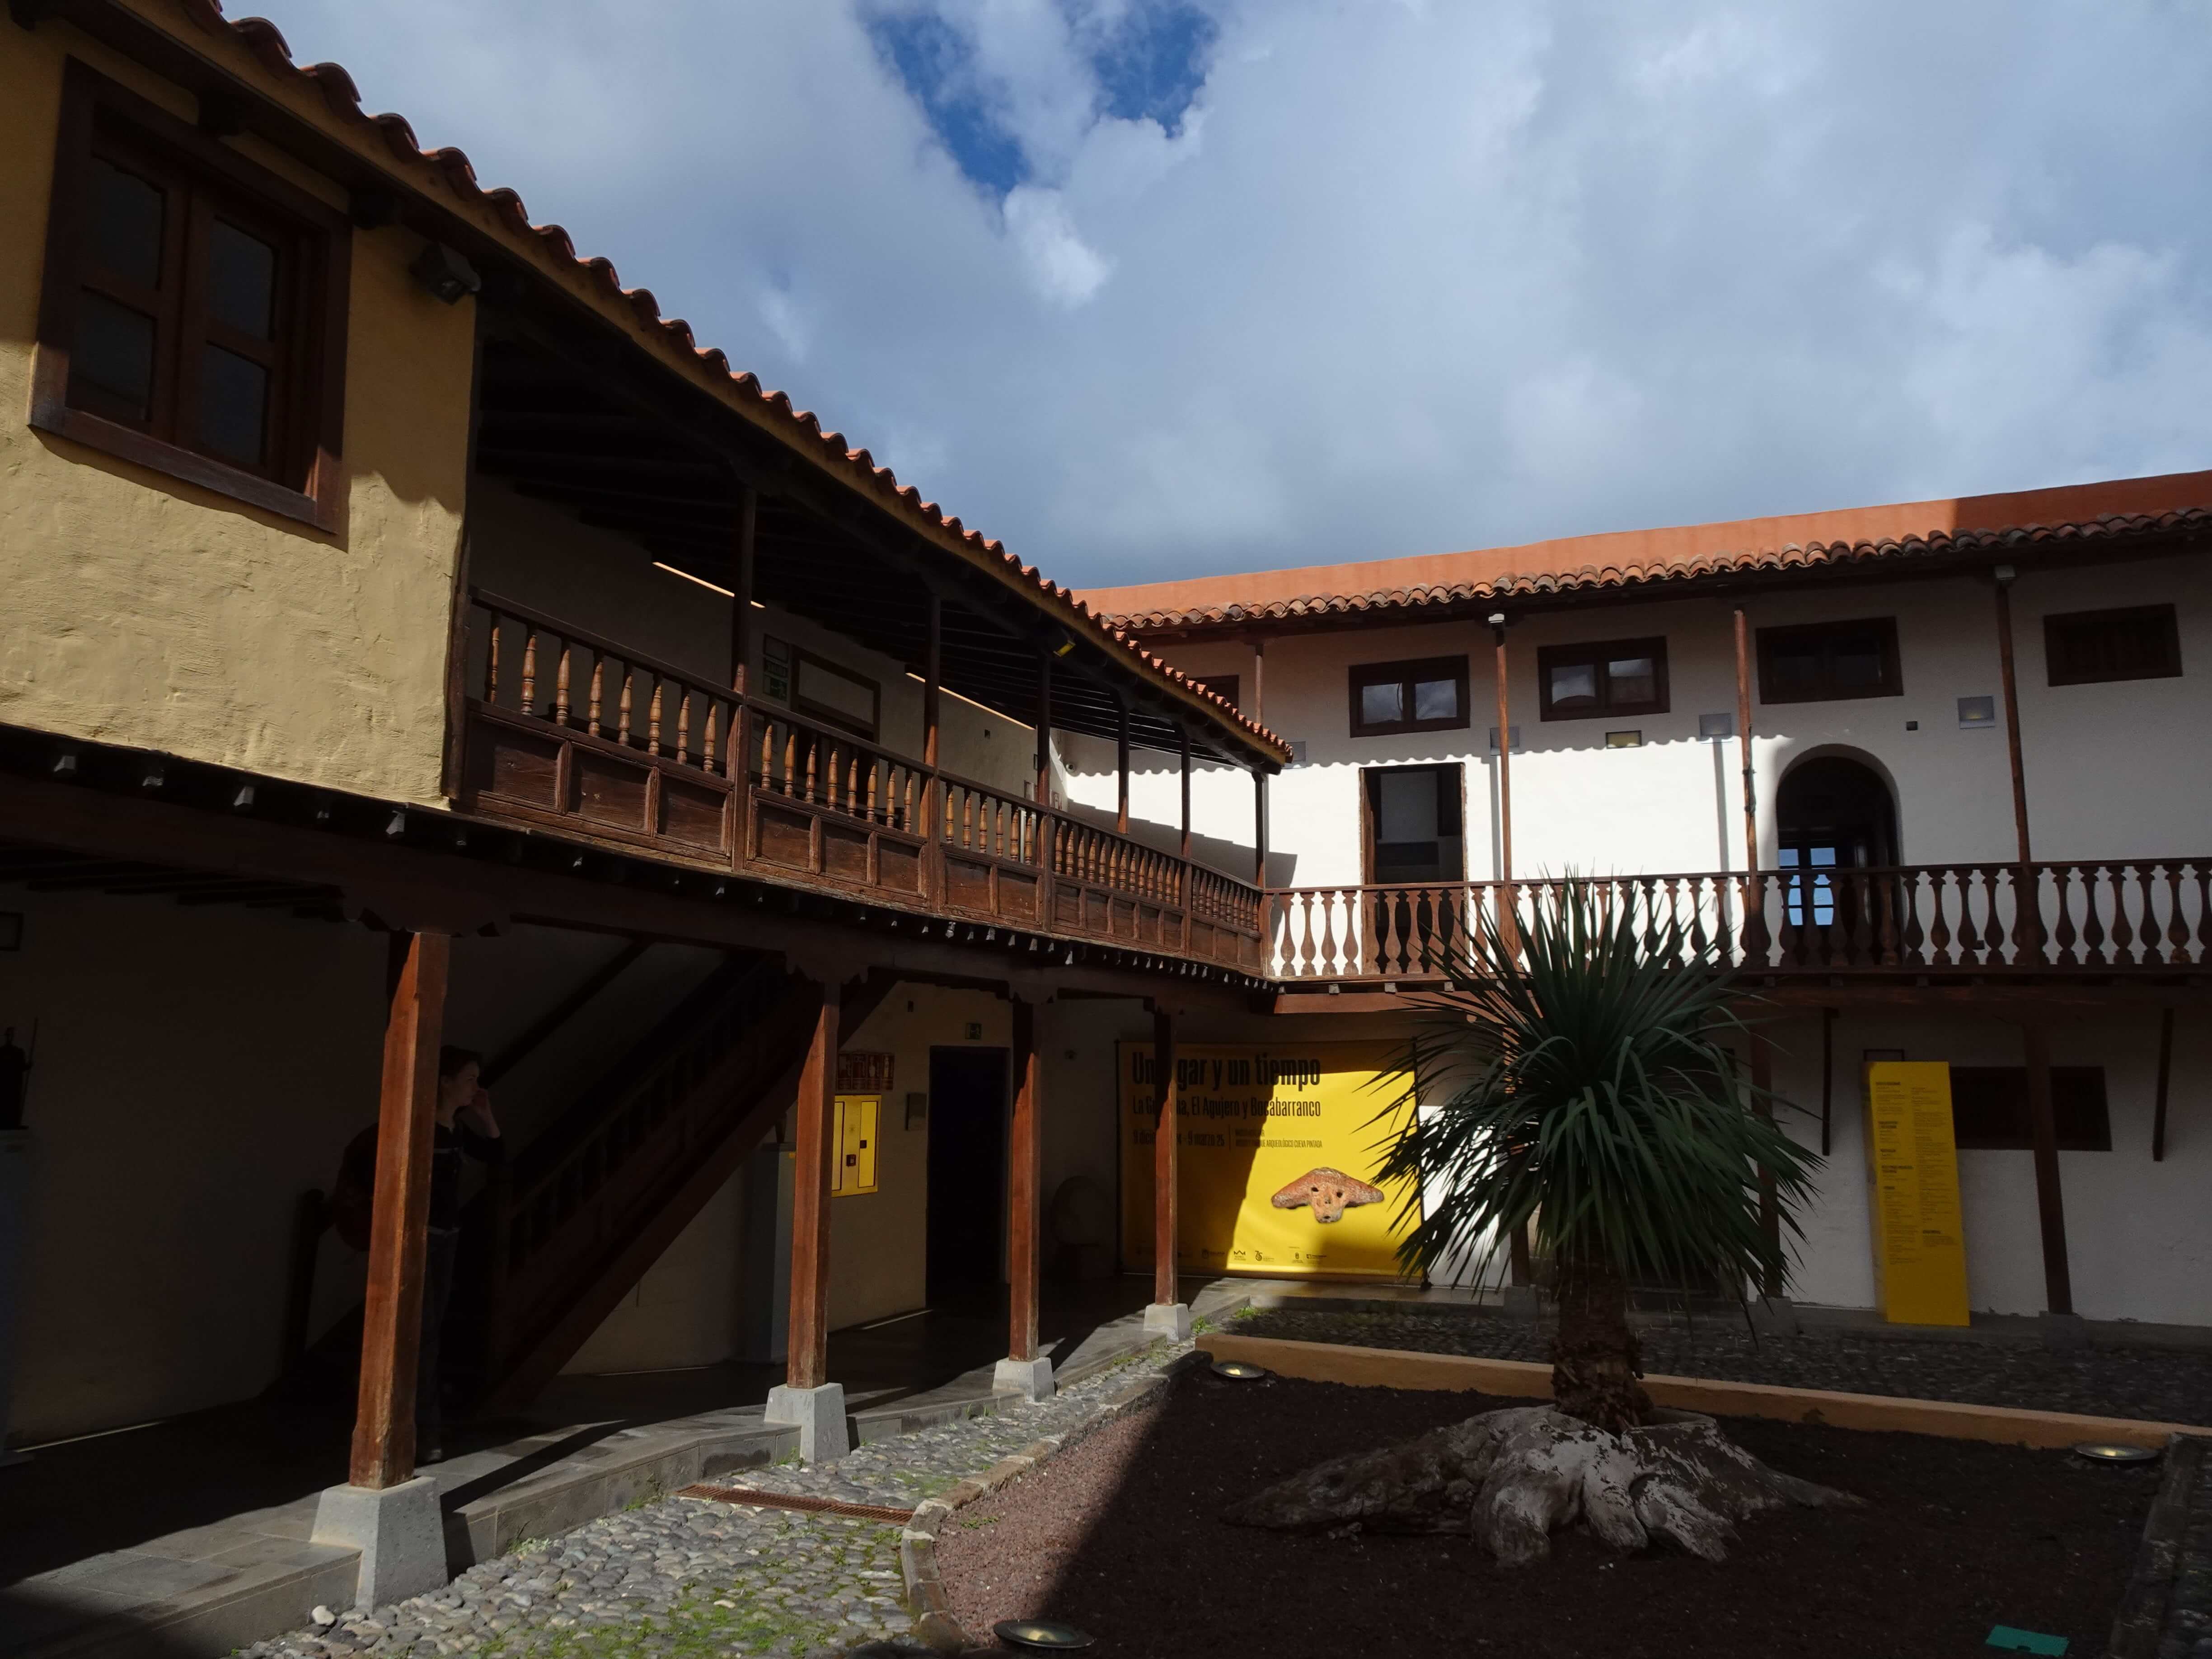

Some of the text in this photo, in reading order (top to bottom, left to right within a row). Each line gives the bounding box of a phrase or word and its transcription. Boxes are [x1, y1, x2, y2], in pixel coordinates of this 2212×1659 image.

[1177, 1059, 1207, 1091] gar
[1212, 1059, 1222, 1091] y
[1228, 1059, 1250, 1085] un
[1255, 1053, 1321, 1091] tiempo
[1133, 1095, 1143, 1114] La
[1191, 1096, 1200, 1115] El
[1203, 1095, 1240, 1119] Agujero
[1242, 1100, 1248, 1119] y
[1251, 1097, 1321, 1117] Bocabarranco
[1188, 1130, 1193, 1146] 9
[1194, 1134, 1214, 1146] marzo
[1216, 1134, 1225, 1147] 25
[1266, 1138, 1293, 1148] ARQUEOLÓGICO
[1307, 1140, 1322, 1148] PINTADA
